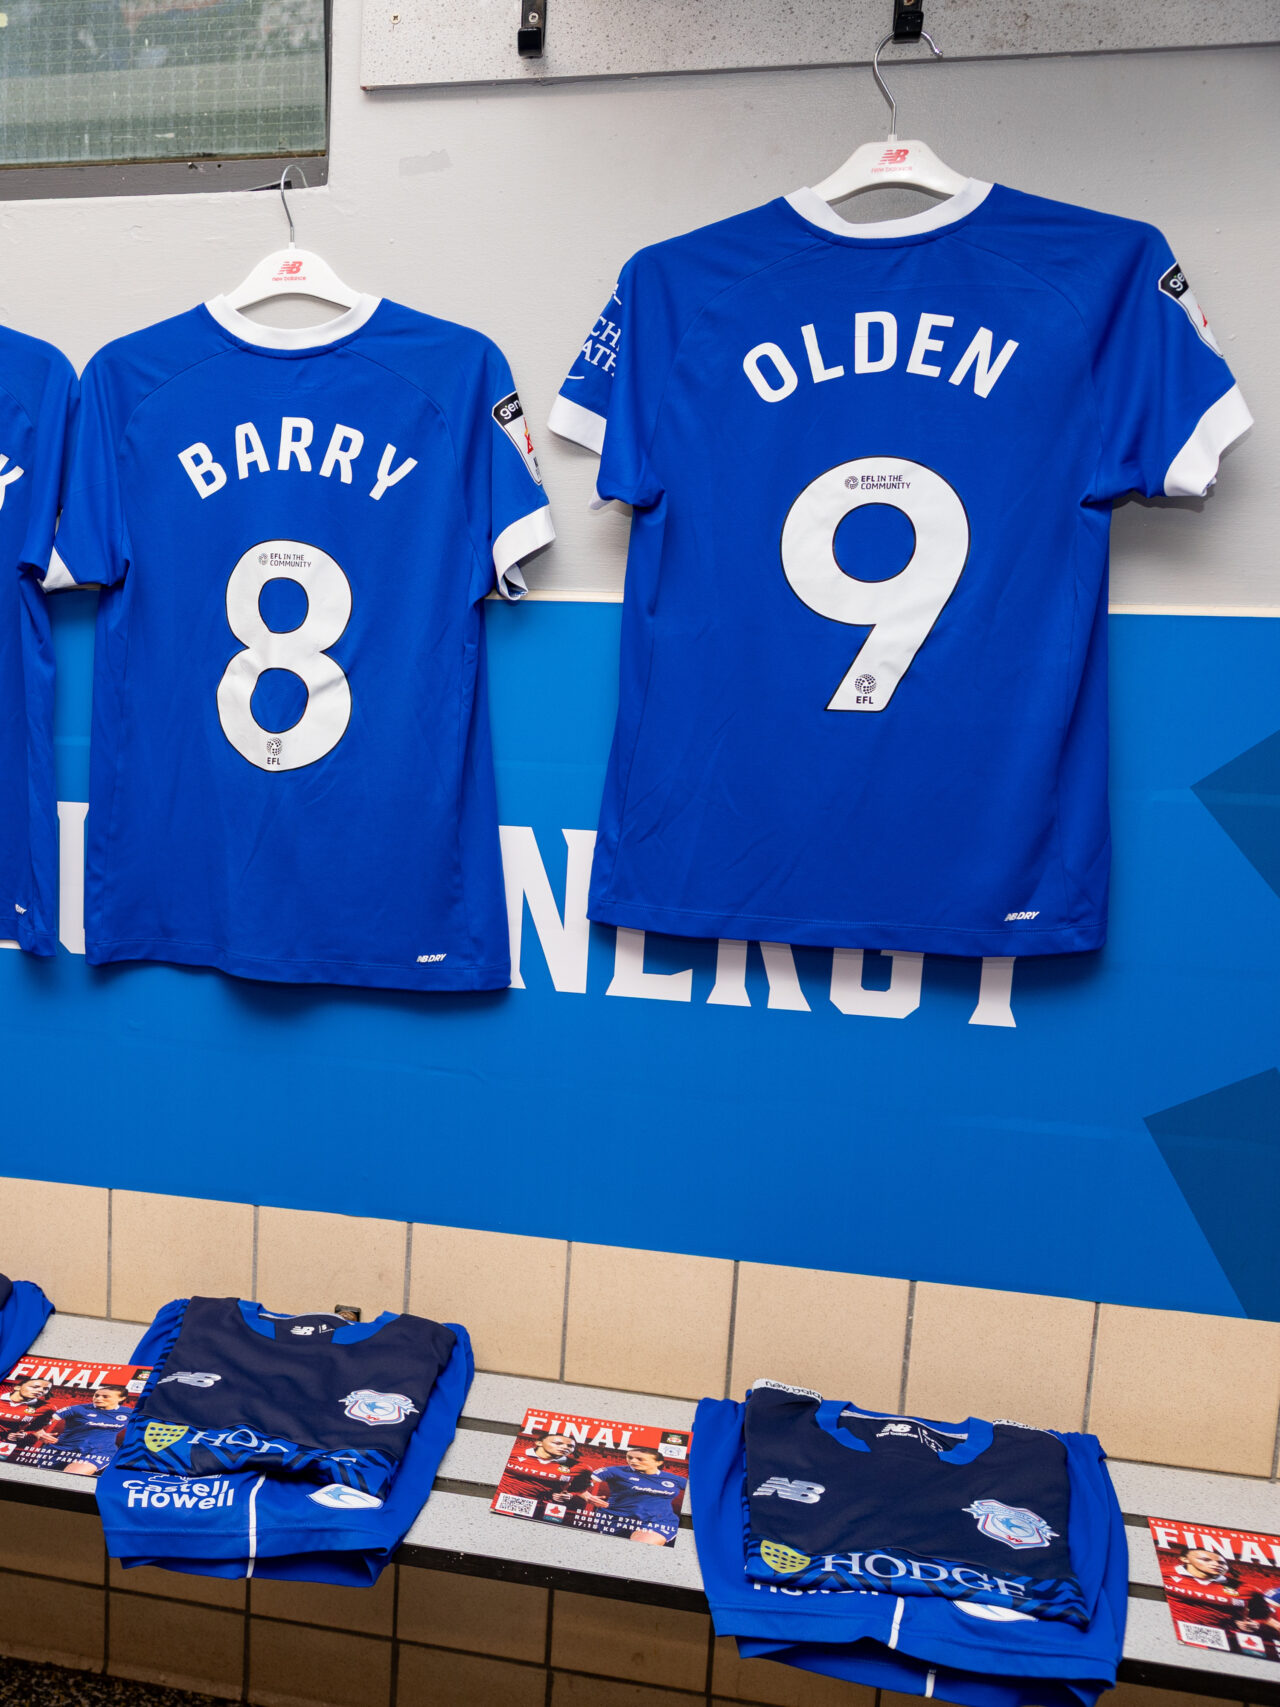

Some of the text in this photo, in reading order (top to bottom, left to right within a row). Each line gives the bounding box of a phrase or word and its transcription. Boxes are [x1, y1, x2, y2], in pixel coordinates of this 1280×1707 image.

[741, 311, 1020, 403] OLDEN
[178, 416, 418, 501] BARRY
[860, 482, 911, 490] COMMUNITY
[270, 560, 312, 568] COMMUNITY
[293, 553, 304, 561] THE
[780, 455, 971, 713] 9
[216, 538, 353, 773] 8
[855, 696, 873, 705] EFL
[266, 757, 280, 765] EFL
[6, 1363, 110, 1390] FINAL
[521, 1415, 633, 1451] FINAL
[882, 1423, 913, 1432] NB
[507, 1463, 557, 1479] UNITED
[122, 1478, 230, 1496] Castell
[752, 1476, 826, 1504] NB
[127, 1487, 235, 1510] Howell
[574, 1514, 654, 1533] RODNEY PARADE
[576, 1508, 676, 1532] SUNDAY 27TH APRIL
[821, 1552, 1033, 1601] HODGE
[1165, 1584, 1228, 1603] UNITED
